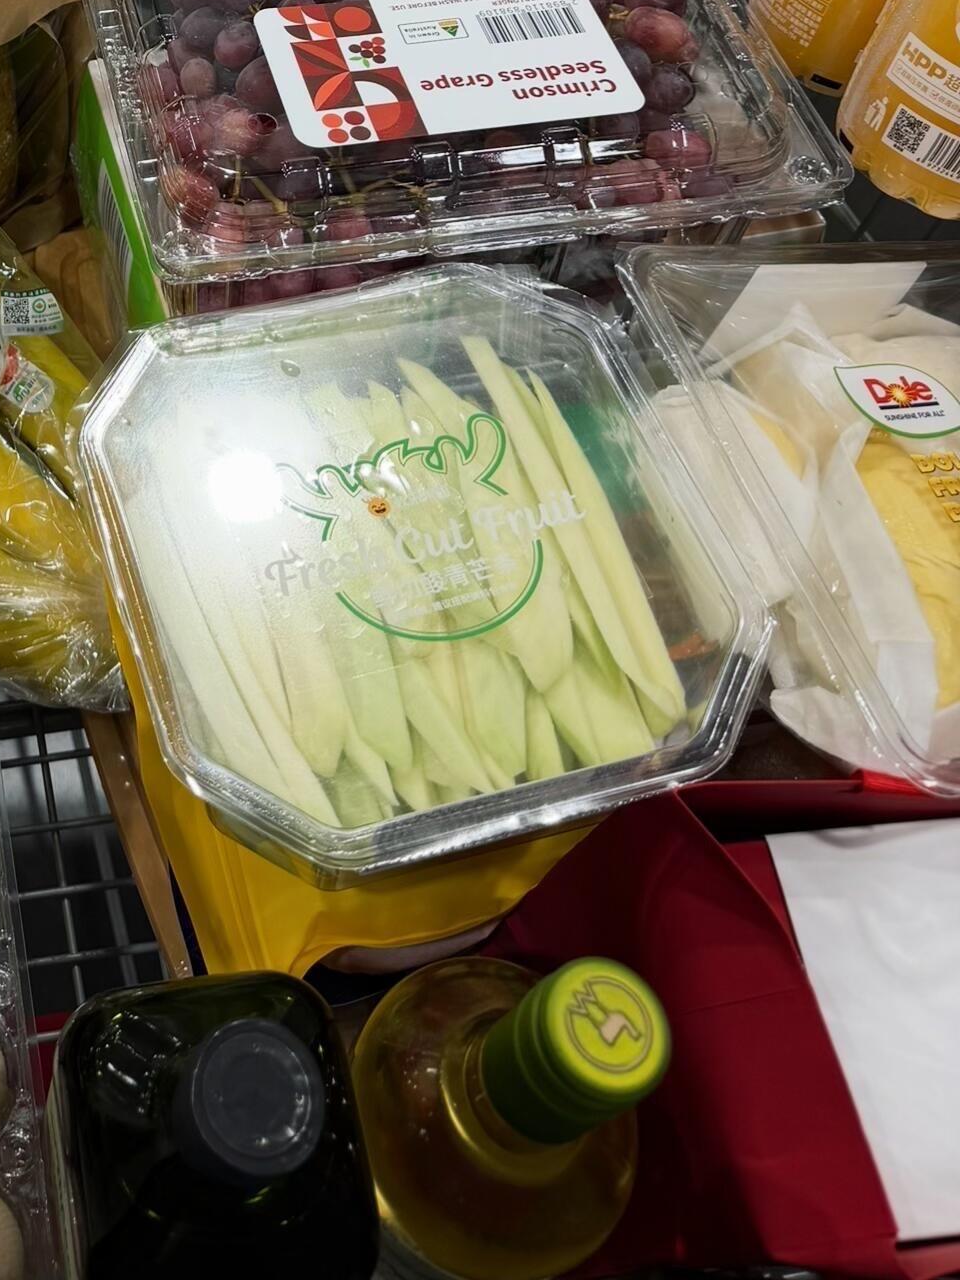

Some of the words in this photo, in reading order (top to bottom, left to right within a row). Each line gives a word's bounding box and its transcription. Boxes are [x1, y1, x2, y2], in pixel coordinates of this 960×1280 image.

[419, 72, 494, 92] Grape
[497, 59, 607, 85] Seedless
[511, 77, 617, 102] Crimson
[863, 375, 934, 408] Dole
[394, 519, 474, 564] Cut
